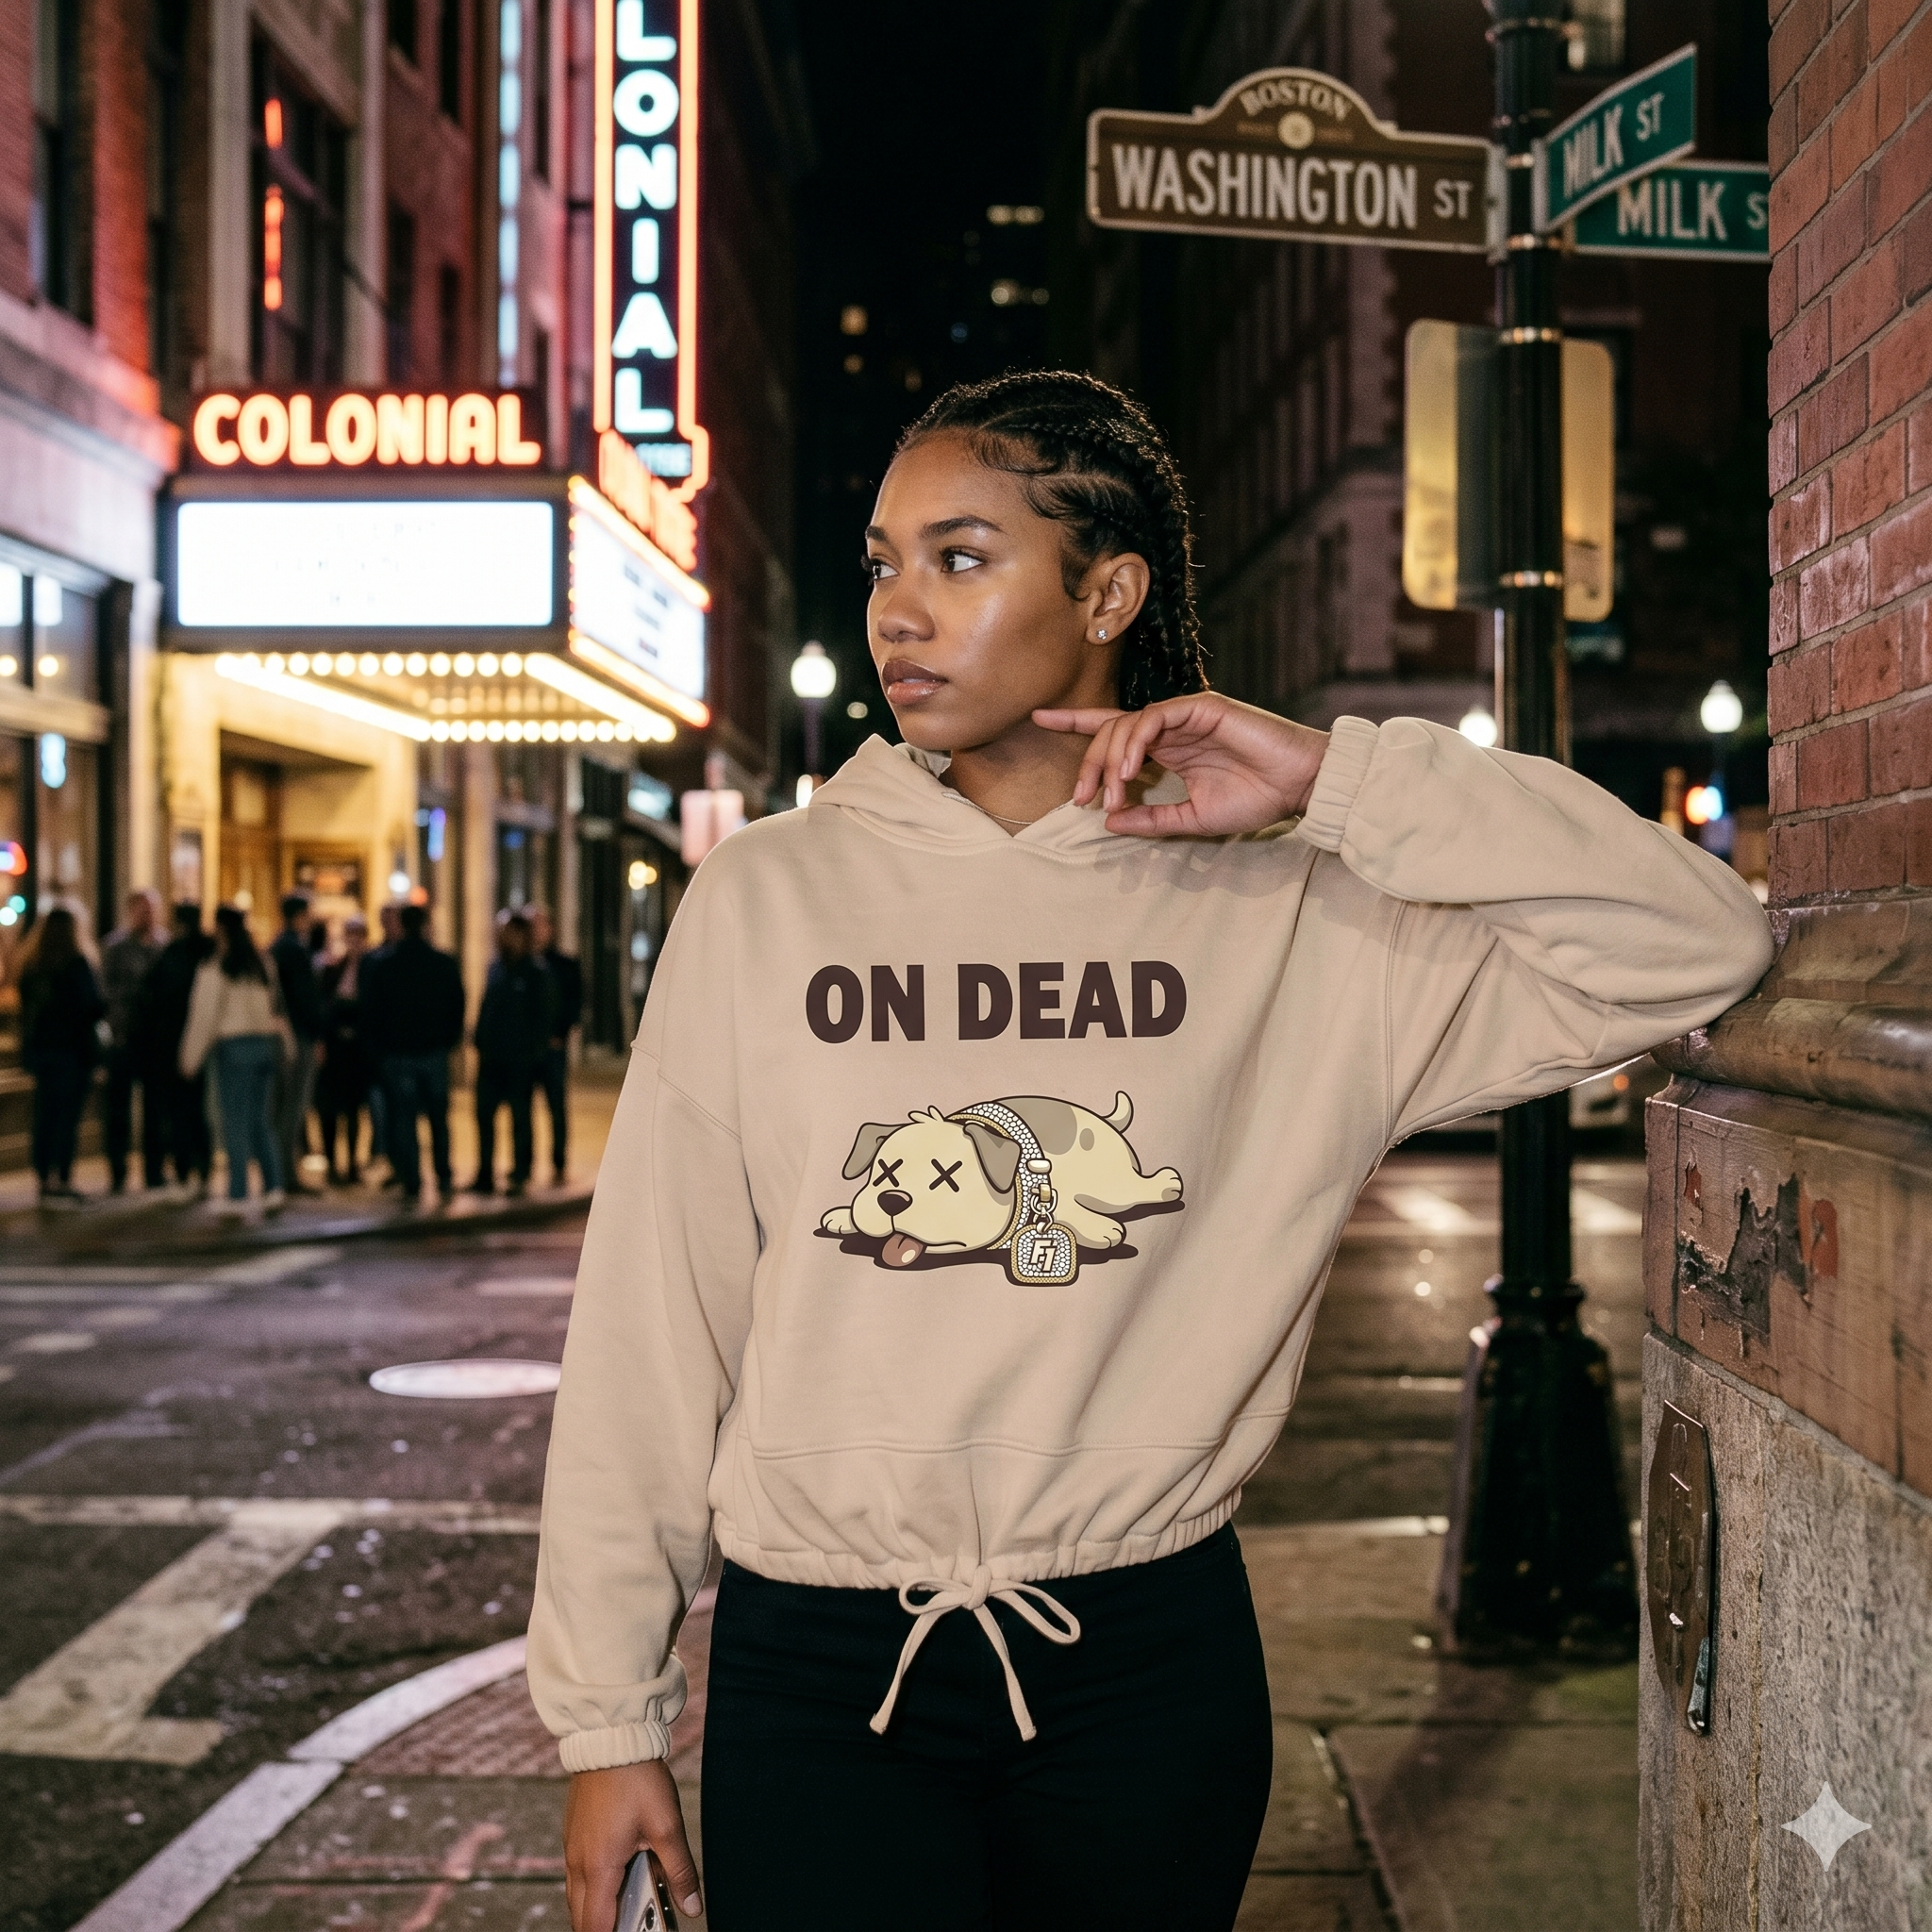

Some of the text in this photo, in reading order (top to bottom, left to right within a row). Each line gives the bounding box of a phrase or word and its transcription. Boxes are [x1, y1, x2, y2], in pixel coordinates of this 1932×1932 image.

[1240, 78, 1352, 122] BOSTON
[1563, 92, 1665, 199] MILK ST
[1111, 144, 1473, 228] WASHINGTON ST
[1617, 179, 1727, 241] MILK
[193, 393, 541, 466] COLONIAL
[806, 960, 1188, 1044] ON DEAD
